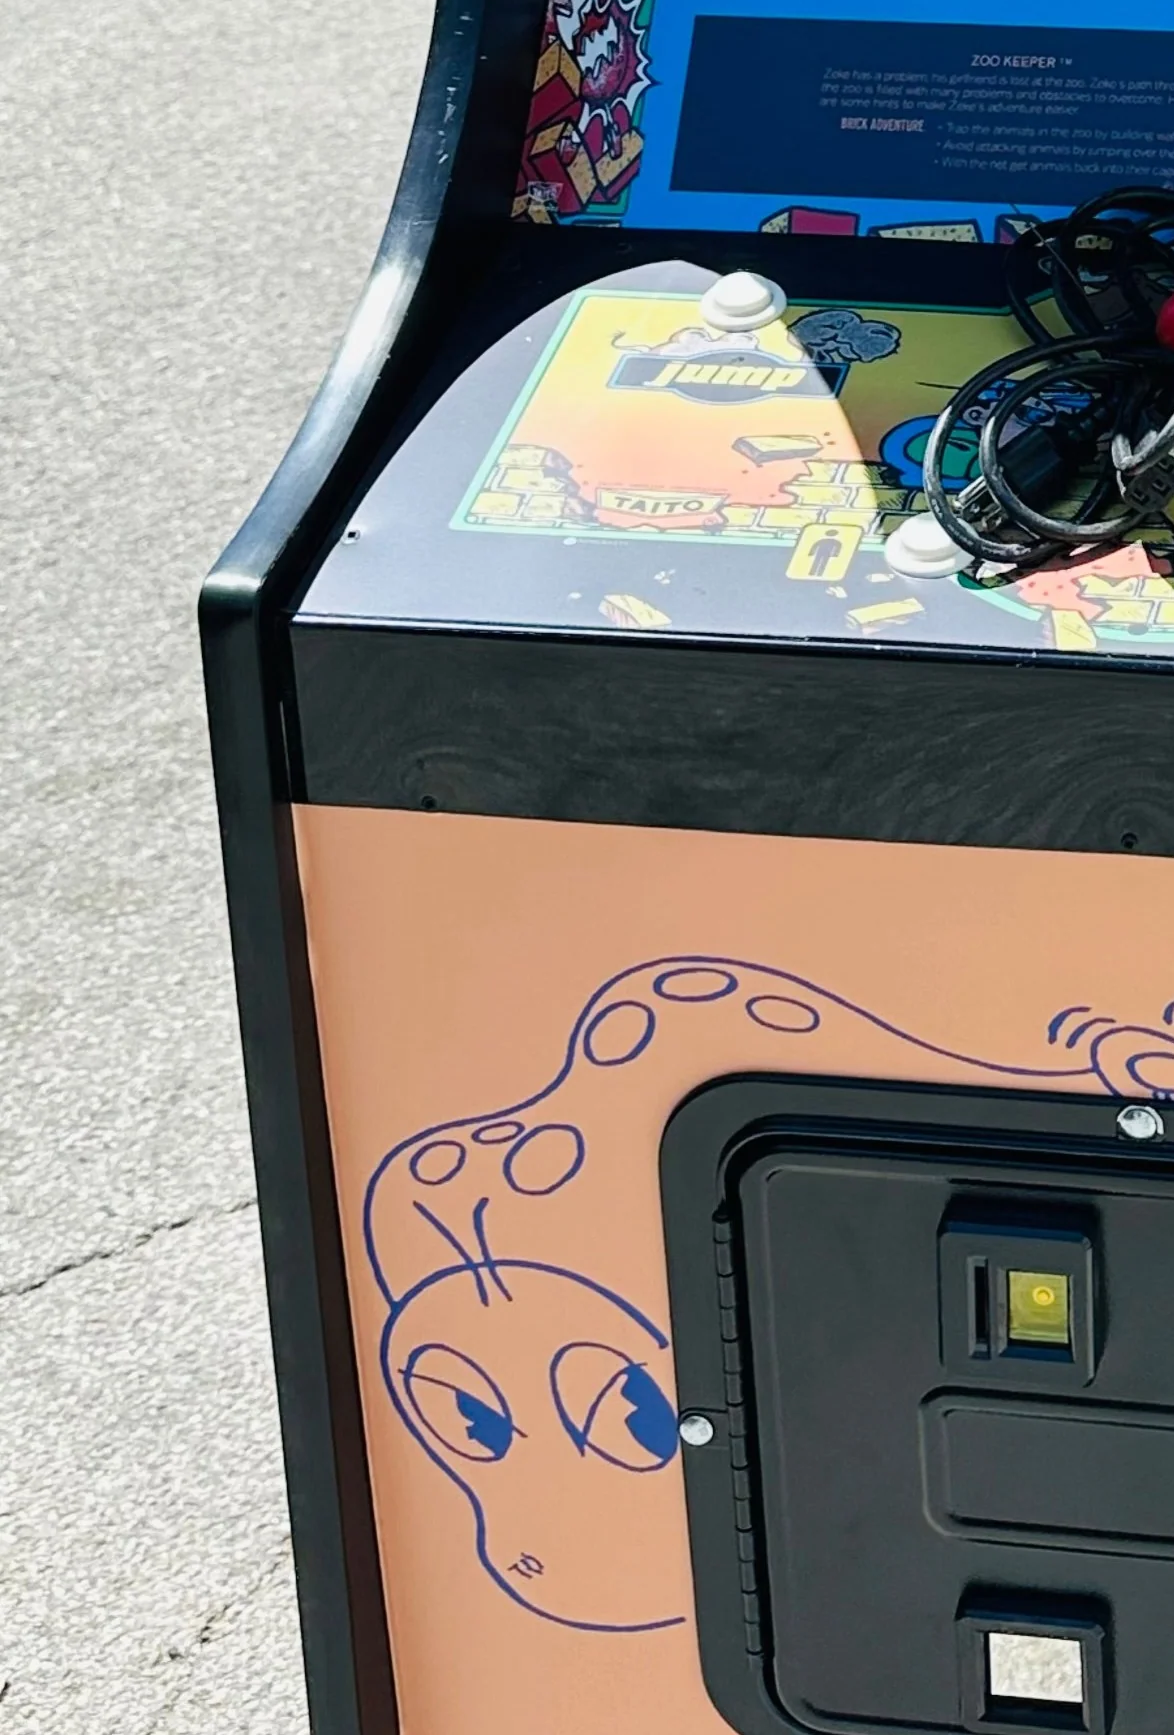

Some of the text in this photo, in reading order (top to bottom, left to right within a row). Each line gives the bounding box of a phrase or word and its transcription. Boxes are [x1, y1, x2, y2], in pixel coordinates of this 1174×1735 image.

[971, 54, 1000, 66] ZOO
[1003, 55, 1056, 68] KEEPER
[840, 117, 868, 130] BRICK
[614, 496, 703, 514] TAITO
